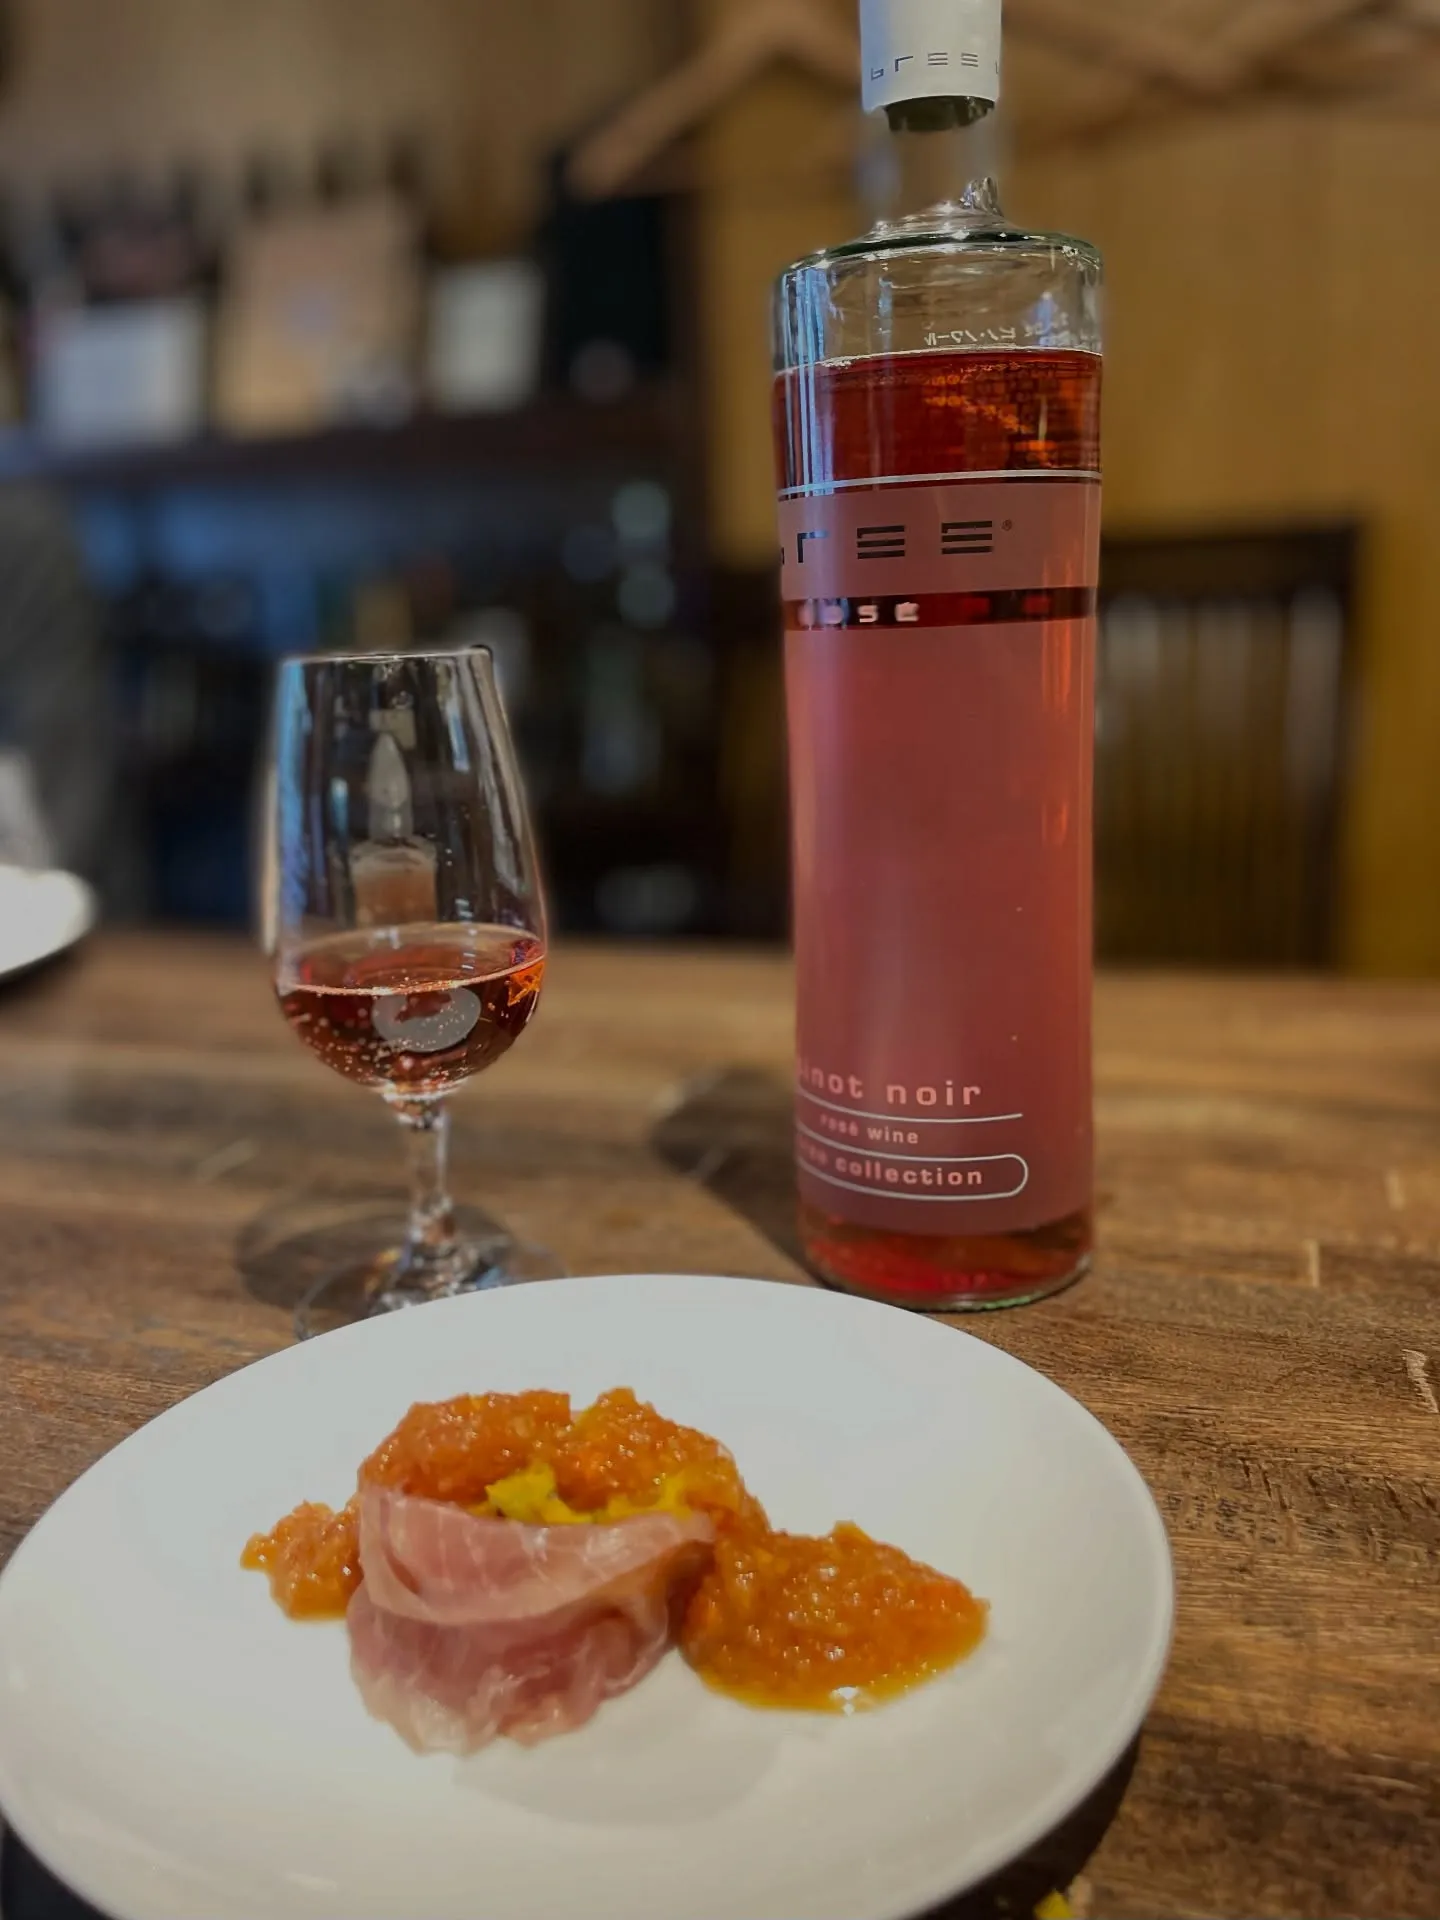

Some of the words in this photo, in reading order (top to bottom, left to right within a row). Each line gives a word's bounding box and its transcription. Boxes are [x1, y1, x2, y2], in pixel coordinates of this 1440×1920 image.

[870, 52, 979, 81] bree
[780, 520, 993, 565] ree
[798, 1060, 864, 1099] inot
[886, 1080, 982, 1106] noir
[867, 1125, 919, 1144] wine
[835, 1156, 983, 1186] collection
